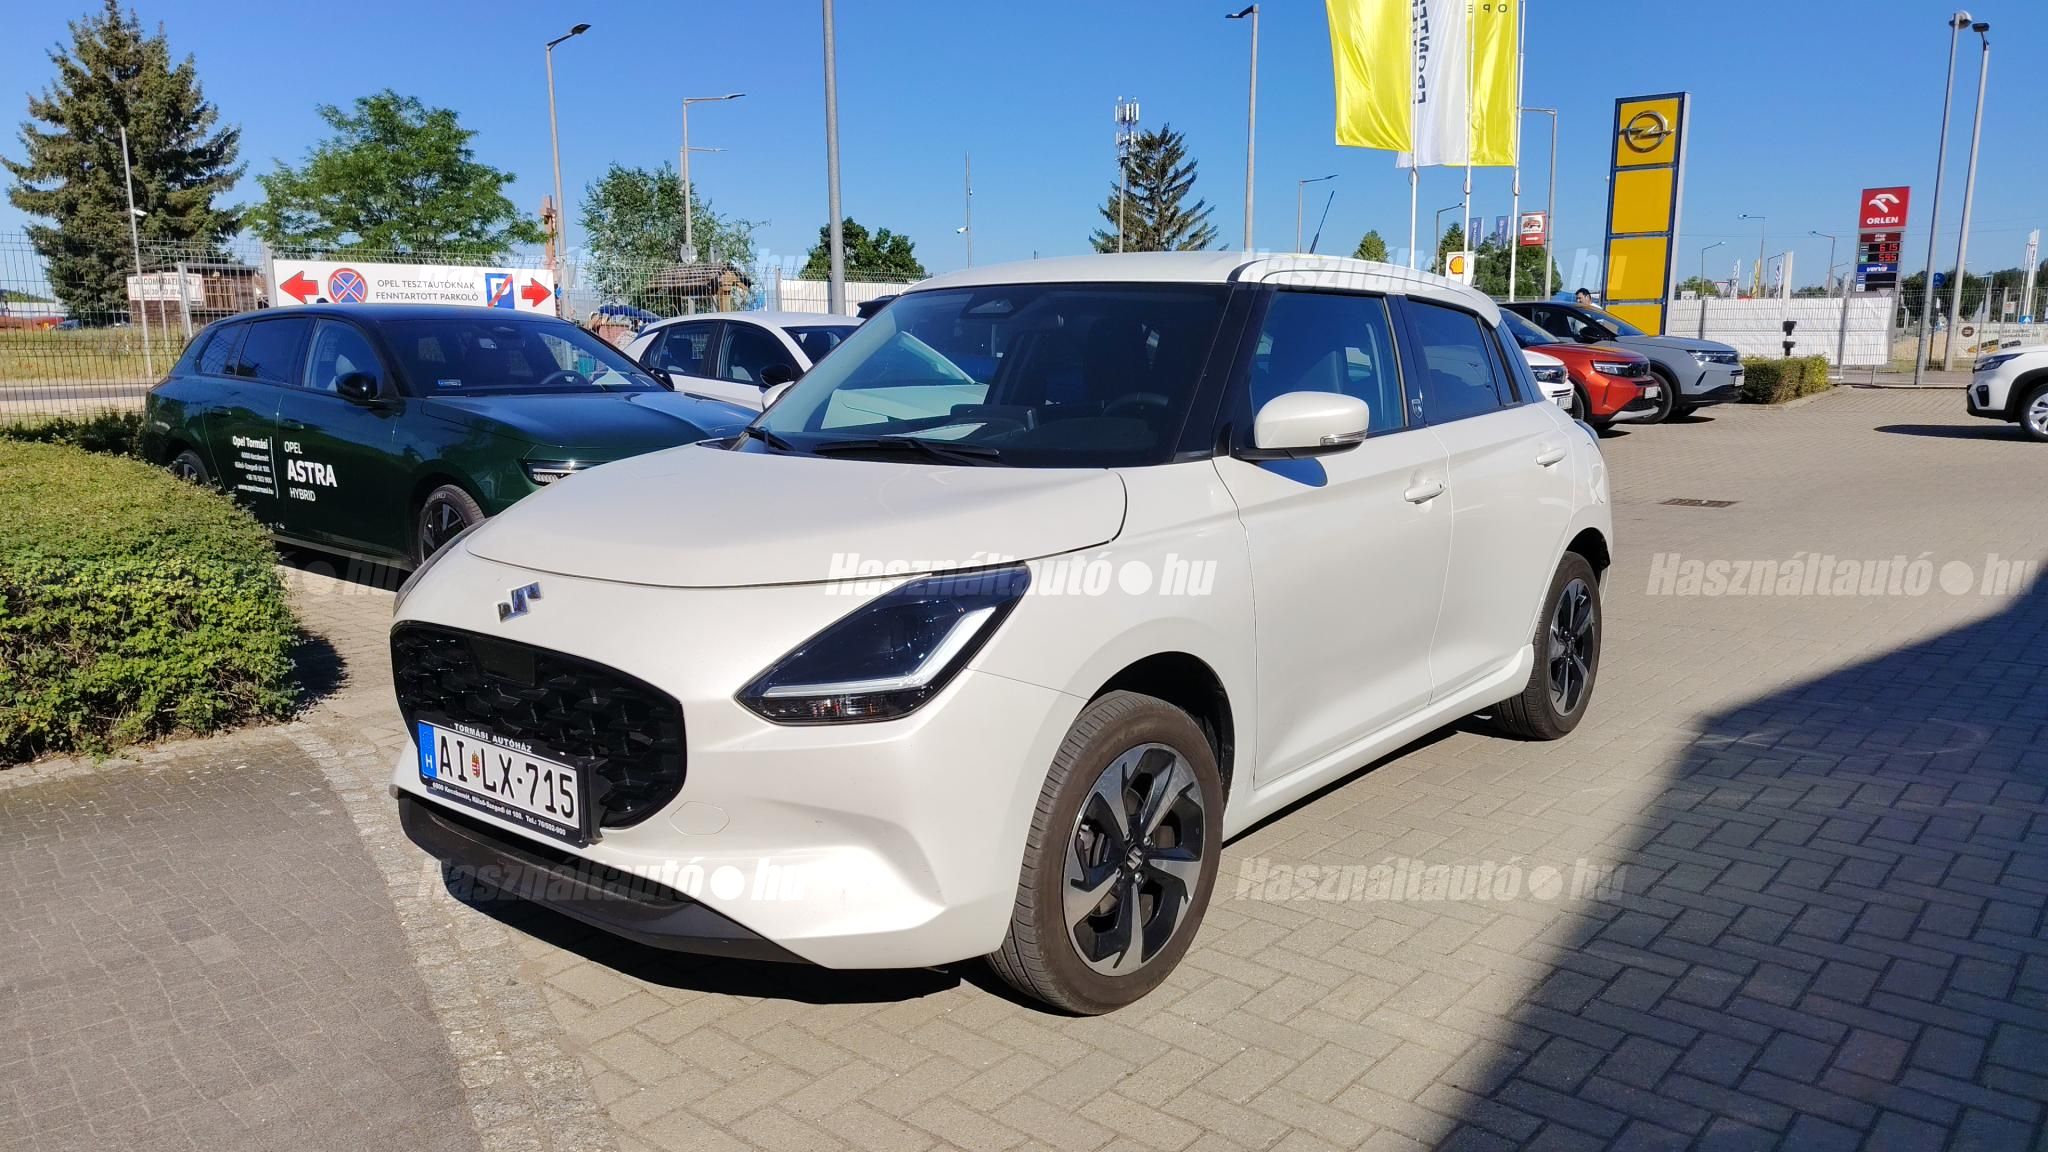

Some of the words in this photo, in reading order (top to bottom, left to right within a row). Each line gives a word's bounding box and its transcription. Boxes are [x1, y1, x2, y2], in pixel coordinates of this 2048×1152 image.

[1866, 216, 1899, 225] ORLEN
[377, 280, 400, 288] OPEL
[401, 279, 475, 290] TESZTAUTÓKNAK
[376, 291, 438, 301] FENNTARTOTT
[440, 292, 479, 302] PARKOLÓ
[232, 435, 245, 448] Opel
[246, 436, 268, 450] Tormási
[284, 441, 303, 454] OPEL
[287, 459, 338, 488] ASTRA
[289, 487, 316, 502] HYBRID
[454, 722, 489, 740] TORMÁSI
[492, 735, 532, 753] AUTÓHÁZ
[425, 754, 433, 769] H
